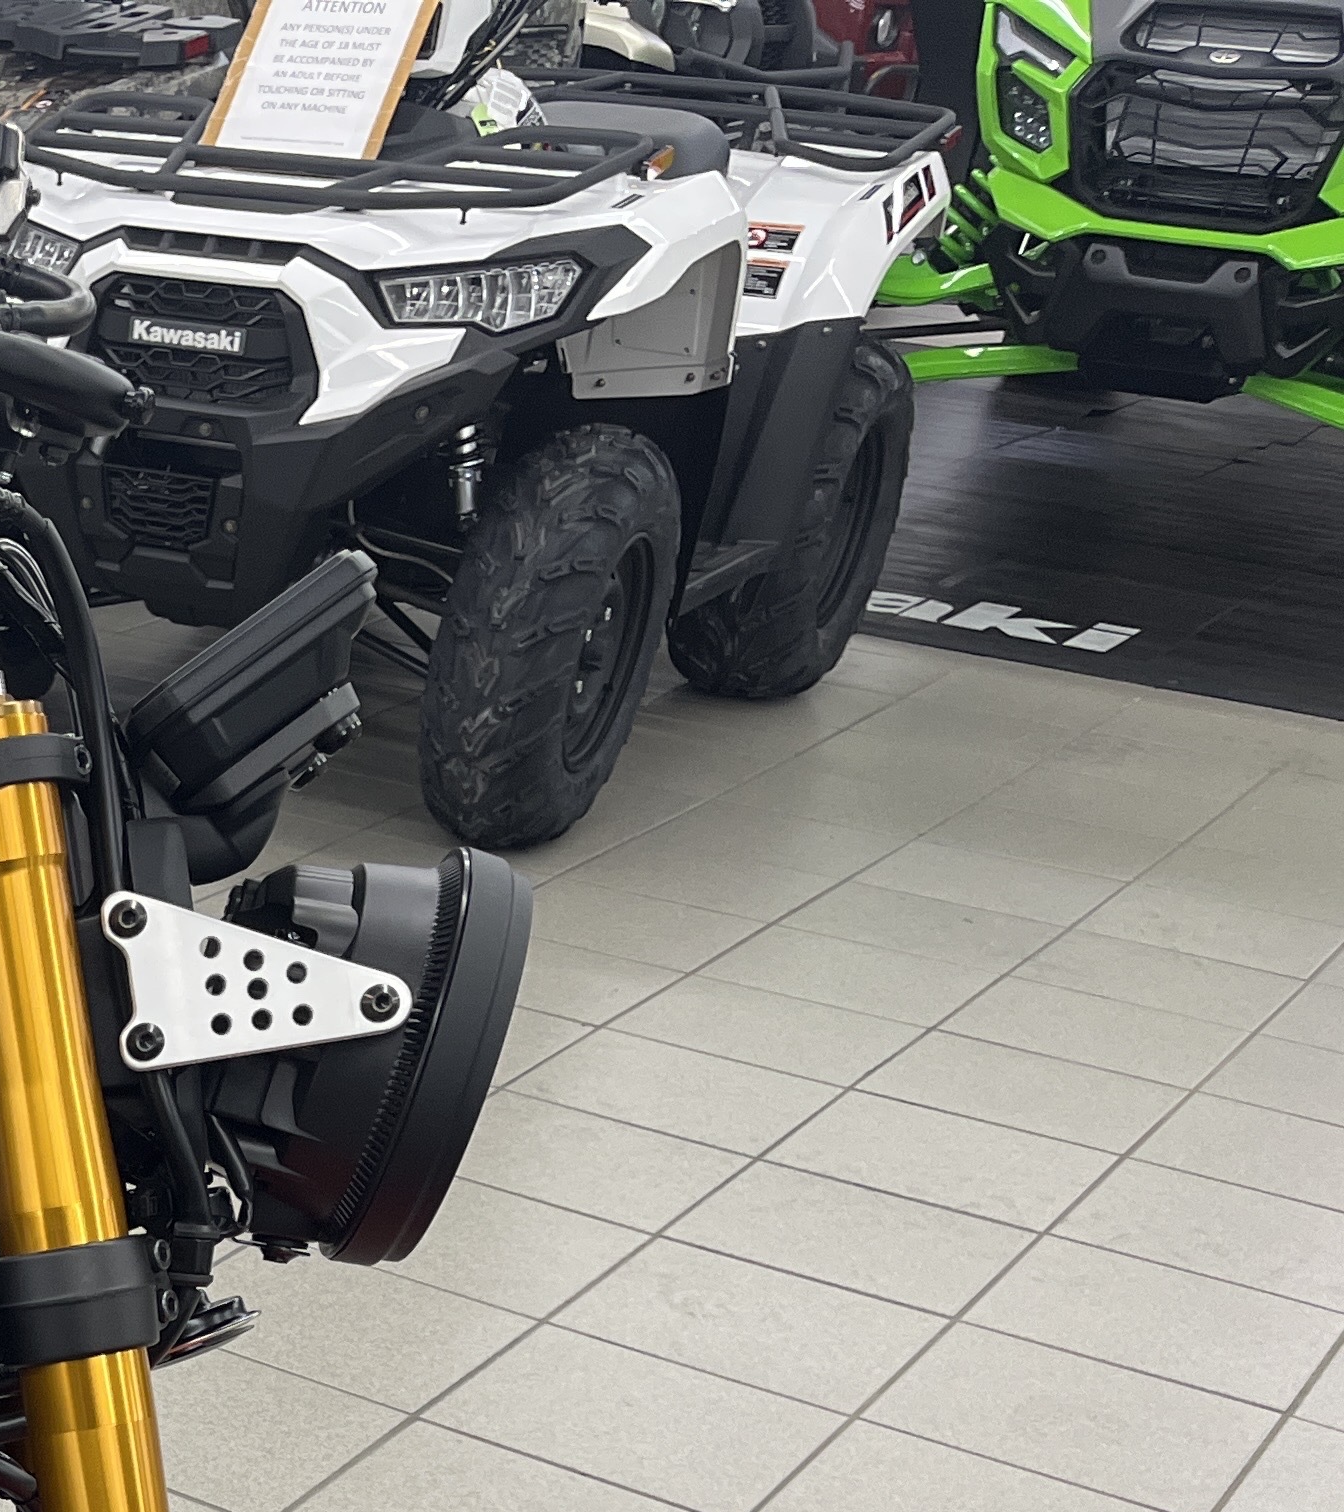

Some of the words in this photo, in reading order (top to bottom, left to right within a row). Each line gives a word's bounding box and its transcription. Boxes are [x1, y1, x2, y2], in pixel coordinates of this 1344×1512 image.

[301, 1, 387, 15] ATTENTION
[280, 22, 301, 32] ANY
[302, 23, 354, 36] PERSON(S)
[355, 25, 391, 36] UNDER
[279, 38, 297, 48] THE
[299, 39, 320, 49] AGE
[321, 40, 336, 50] OF
[352, 41, 382, 52] MUST
[286, 54, 361, 67] ACCOMPANIED
[362, 57, 376, 68] BY
[289, 70, 323, 81] ADULT
[323, 72, 362, 83] BEFORE
[258, 84, 309, 96] TOUCHING
[310, 86, 326, 97] OR
[327, 87, 366, 100] SITTING
[261, 100, 278, 110] ON
[278, 101, 299, 111] ANY
[300, 102, 348, 115] MACHINE
[132, 319, 241, 352] Kawasaki
